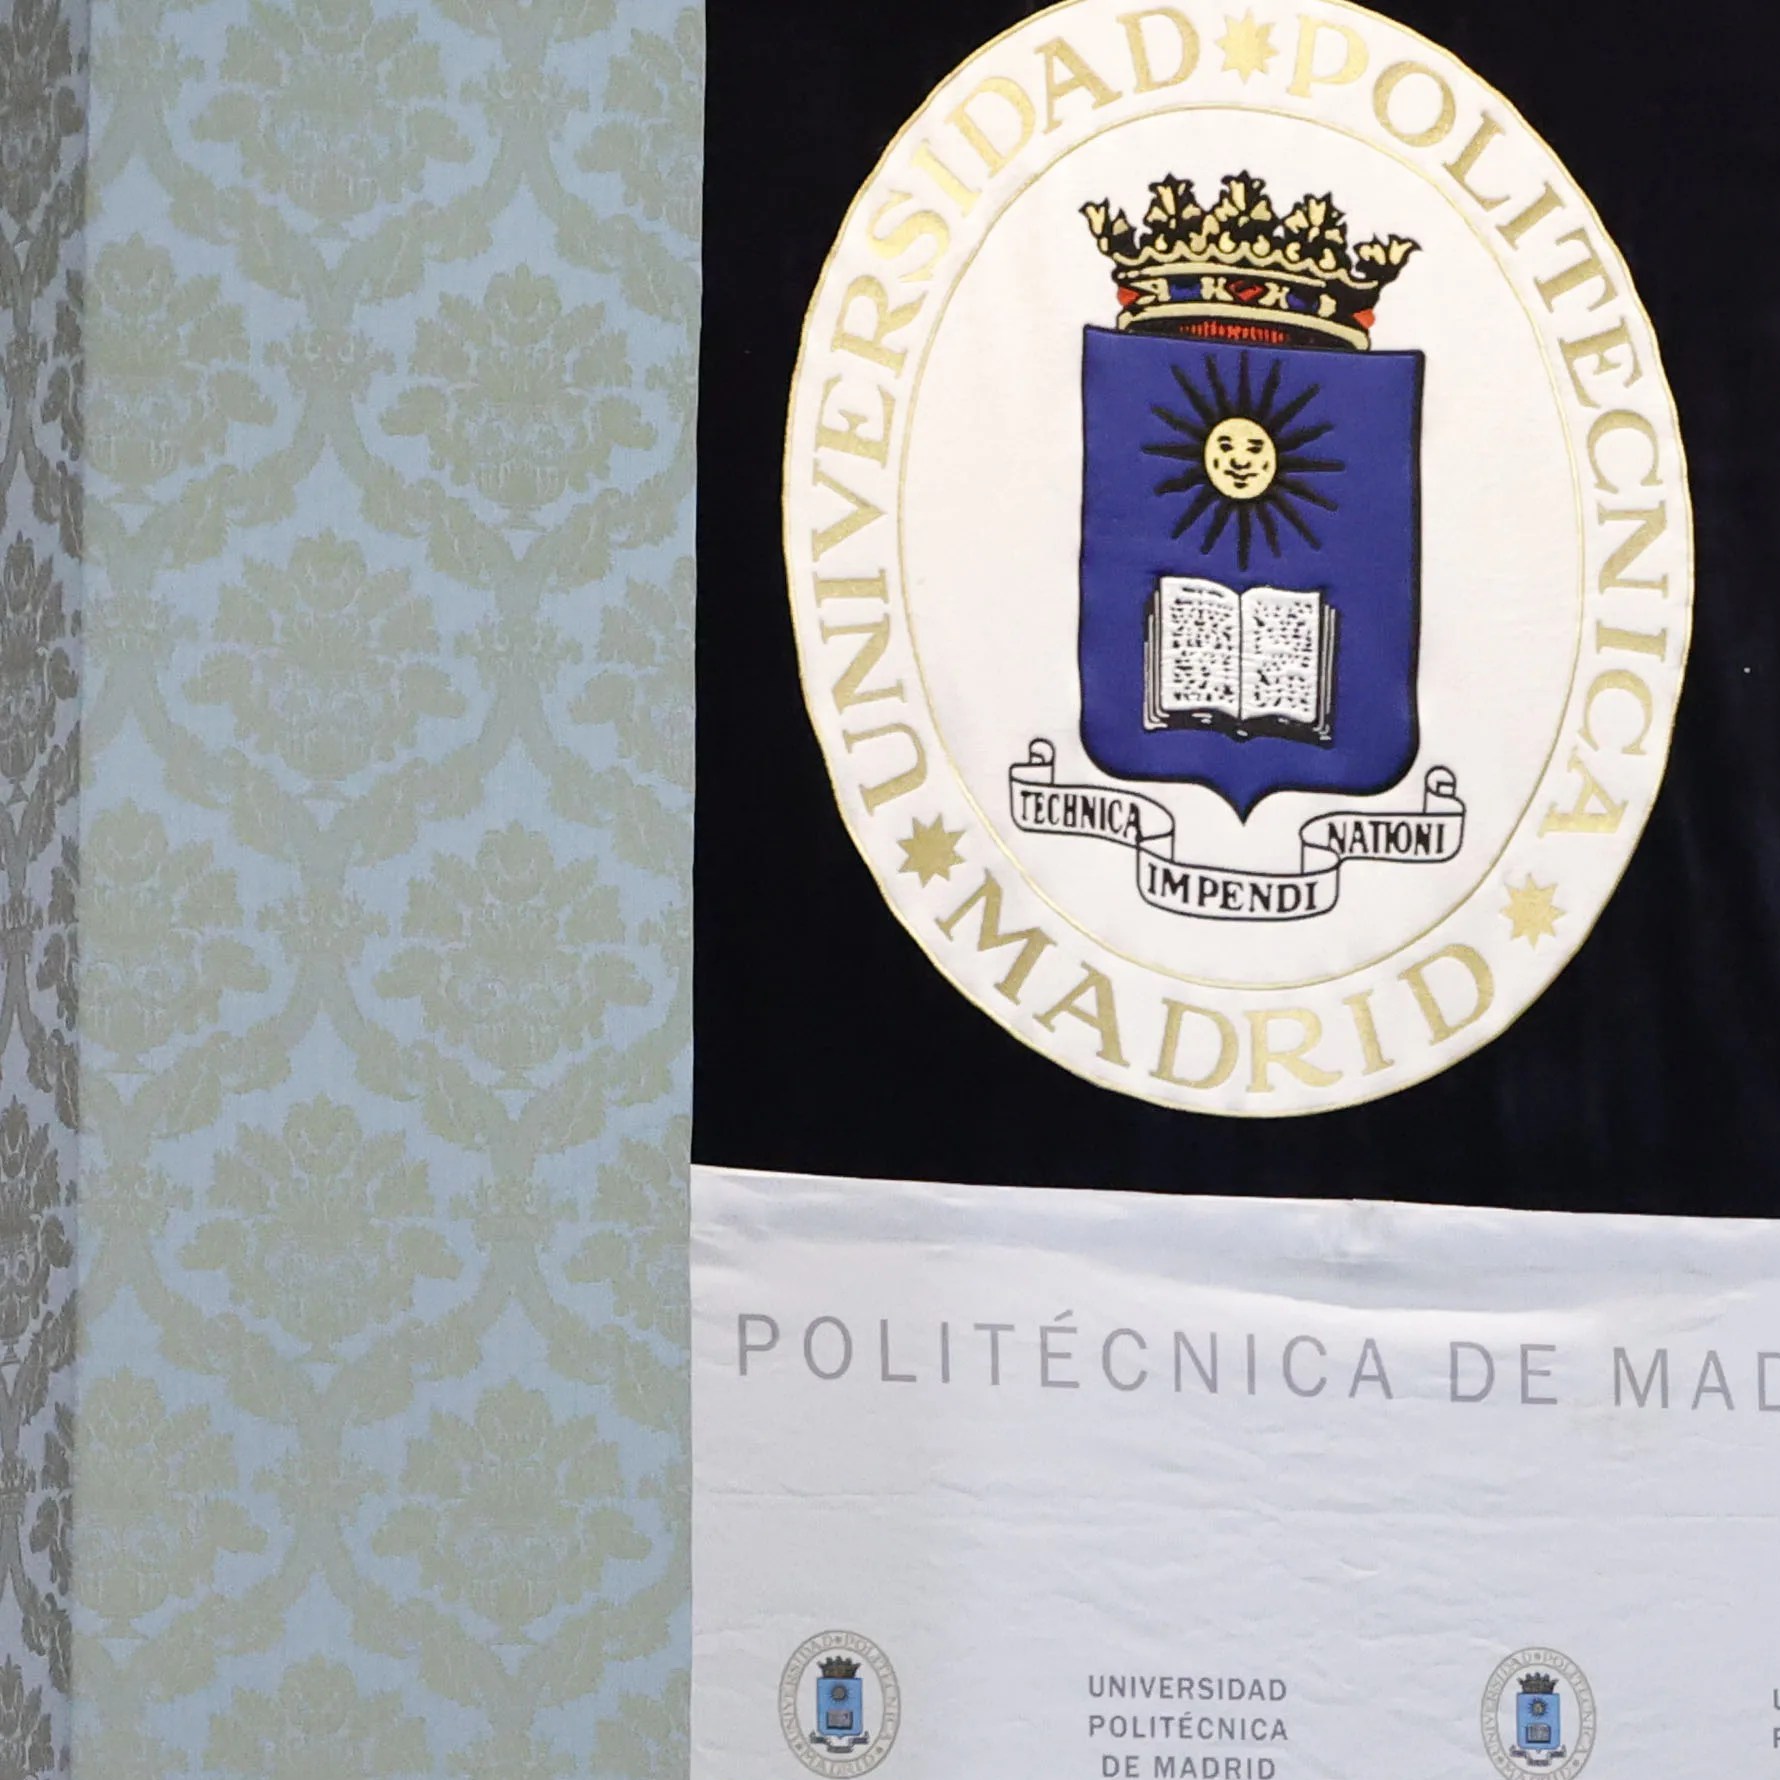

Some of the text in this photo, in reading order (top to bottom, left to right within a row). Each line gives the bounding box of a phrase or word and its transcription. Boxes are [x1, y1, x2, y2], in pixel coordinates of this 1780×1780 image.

[811, 4, 1672, 1095] UNIVERSIDAD POLITECNICA MADRID
[1147, 862, 1319, 914] IMPENDI
[1327, 821, 1446, 857] NATIONI
[738, 1310, 1393, 1399] POLITÉCNICA
[1450, 1342, 1557, 1405] DE
[1089, 1675, 1286, 1701] UNIVERSIDAD
[1089, 1712, 1288, 1741] POLITÉCNICA
[1103, 1755, 1275, 1780] DE MADRID
